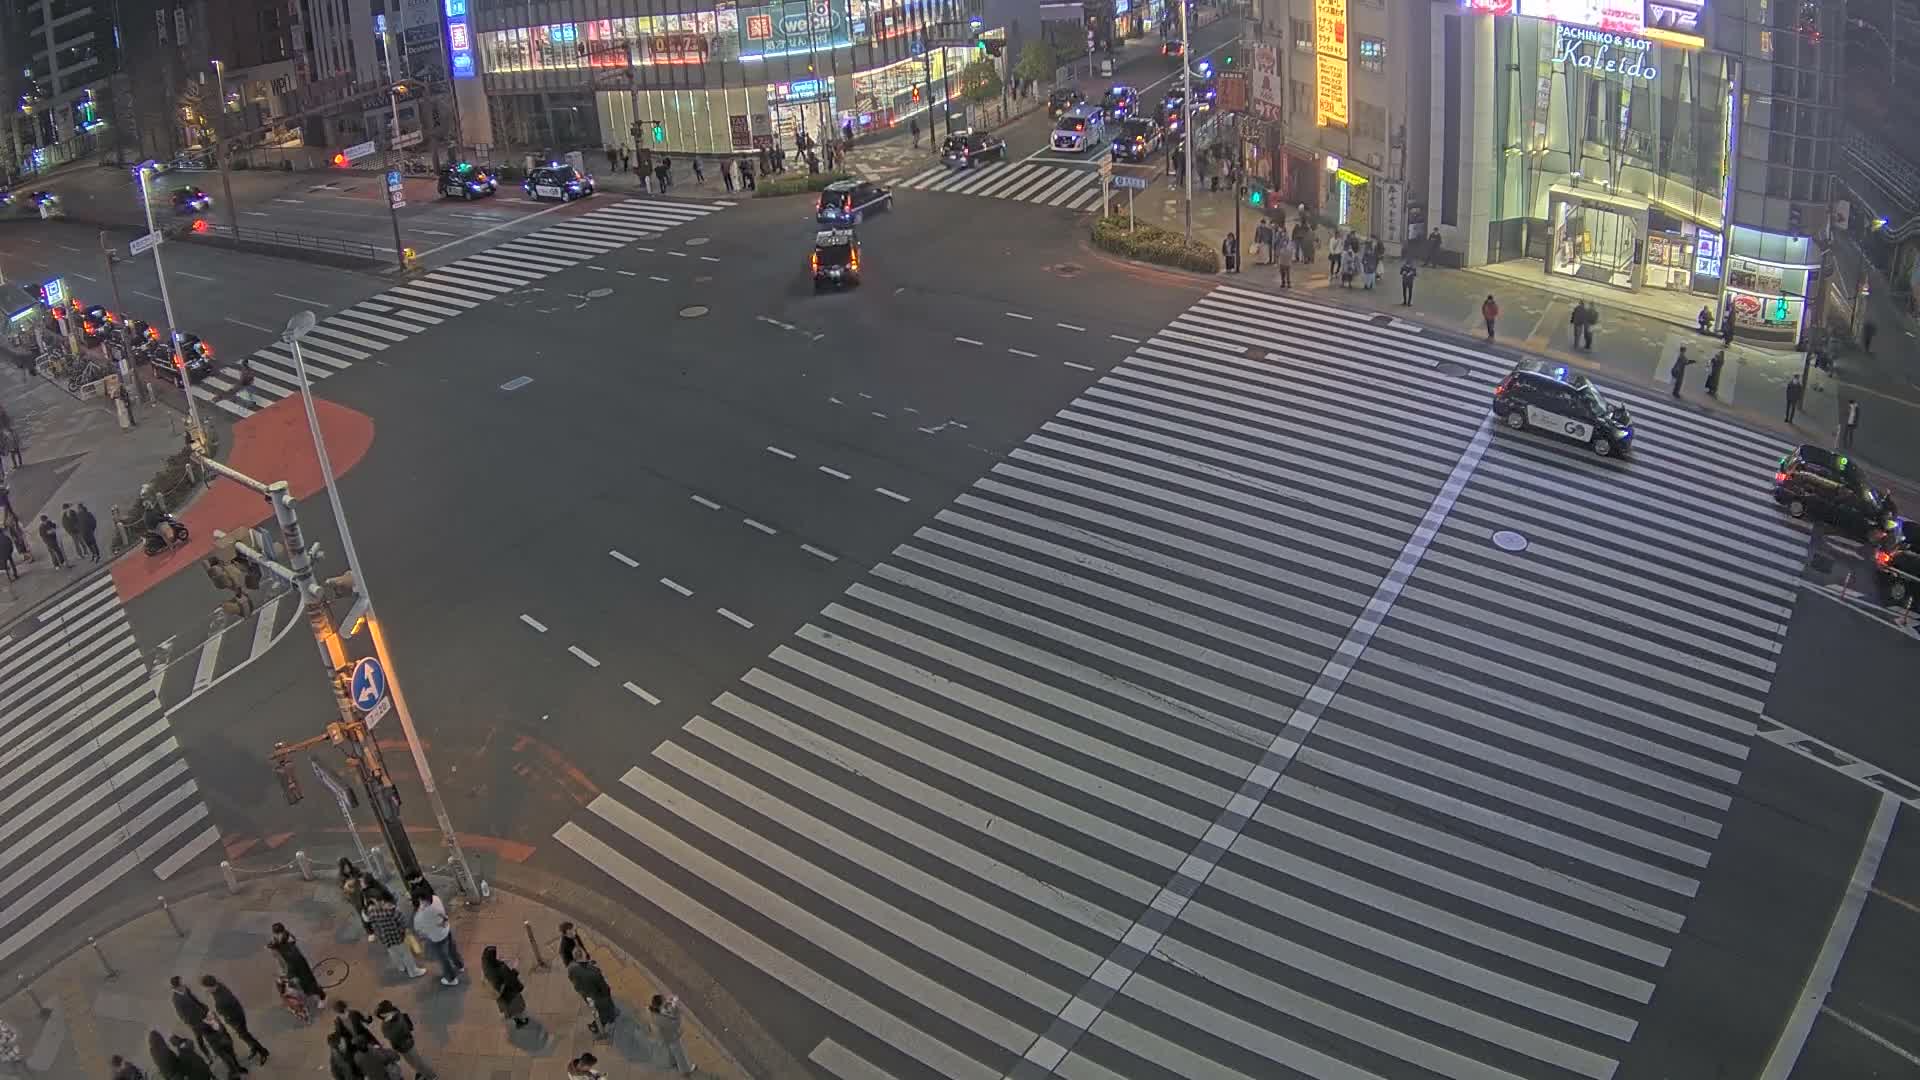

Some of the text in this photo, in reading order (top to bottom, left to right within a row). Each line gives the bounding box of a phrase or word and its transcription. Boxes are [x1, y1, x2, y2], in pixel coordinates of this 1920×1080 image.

[1556, 25, 1652, 51] PACHINKO & SLOT
[1551, 37, 1657, 80] Kaleido
[1564, 421, 1586, 438] GO
